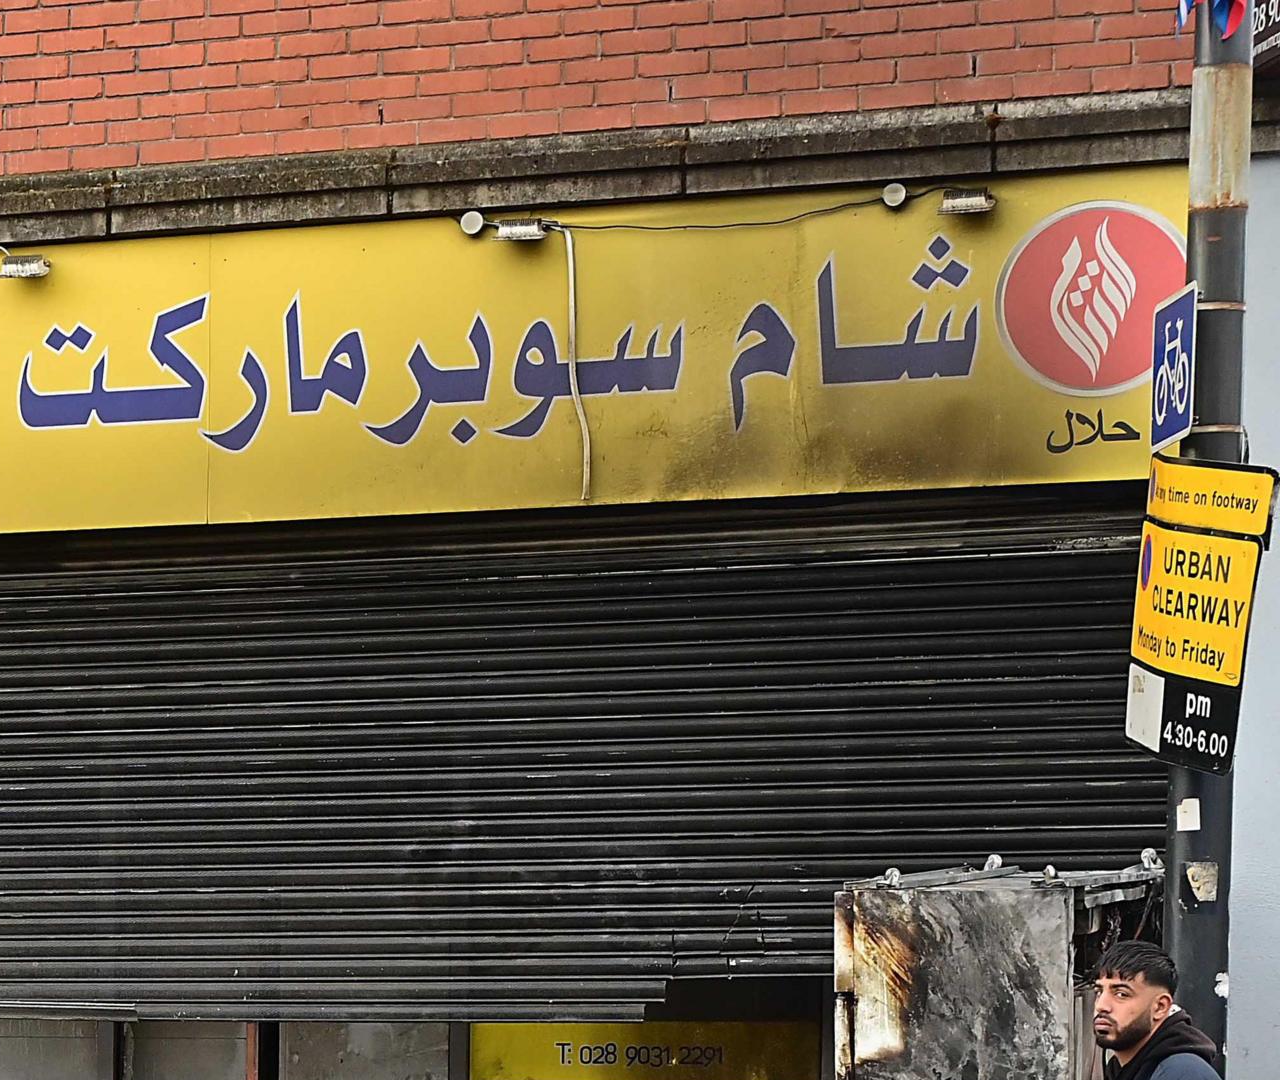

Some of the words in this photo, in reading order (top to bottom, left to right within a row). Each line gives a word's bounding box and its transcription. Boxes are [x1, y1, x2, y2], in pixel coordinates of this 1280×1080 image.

[729, 235, 981, 434] شام
[18, 290, 686, 453] سوبرماركت
[1046, 409, 1140, 455] حلال
[1168, 486, 1190, 504] time
[1193, 491, 1207, 506] on
[1212, 491, 1259, 514] footway
[1164, 547, 1231, 583] URBAN
[1152, 585, 1245, 628] CLEARWAY
[1137, 624, 1162, 658] Monday
[1165, 635, 1176, 658] to
[1181, 639, 1225, 672] Friday
[1185, 693, 1211, 718] pm
[1163, 721, 1228, 758] 4.30-6.00
[579, 1043, 618, 1066] 028
[625, 1045, 673, 1068] 9031
[677, 1046, 724, 1066] 2291
